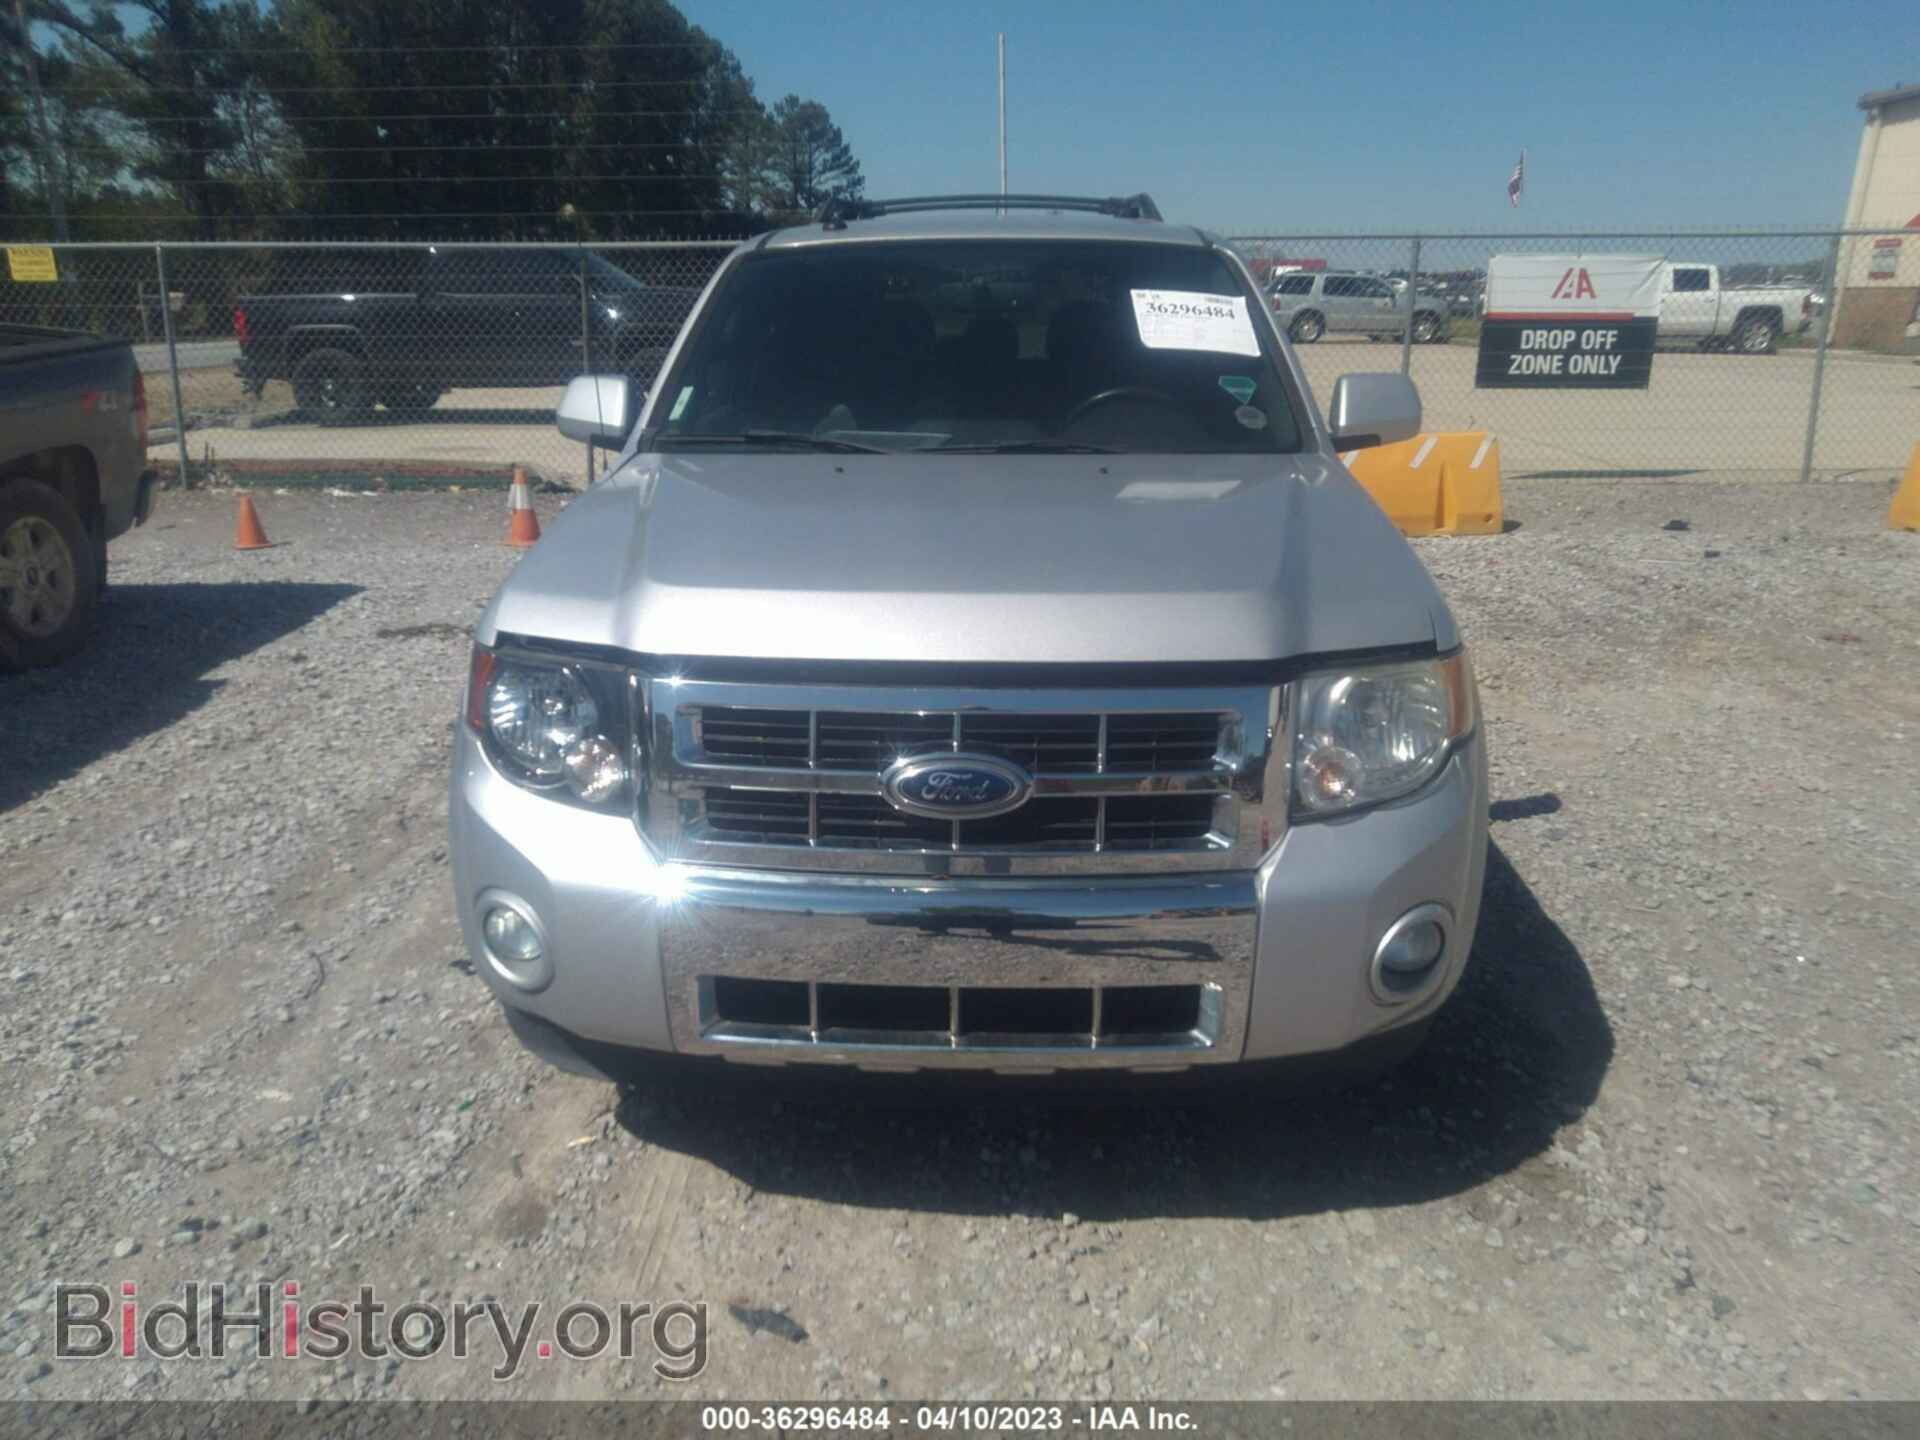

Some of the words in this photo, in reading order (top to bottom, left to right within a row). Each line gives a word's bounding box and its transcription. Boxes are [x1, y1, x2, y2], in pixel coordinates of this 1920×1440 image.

[1145, 302, 1235, 320] 36296484
[1519, 329, 1578, 351] DROP
[1580, 329, 1619, 351] OFF
[1507, 354, 1564, 376] ZONE
[1568, 354, 1622, 376] ONLY
[920, 771, 991, 801] Ford
